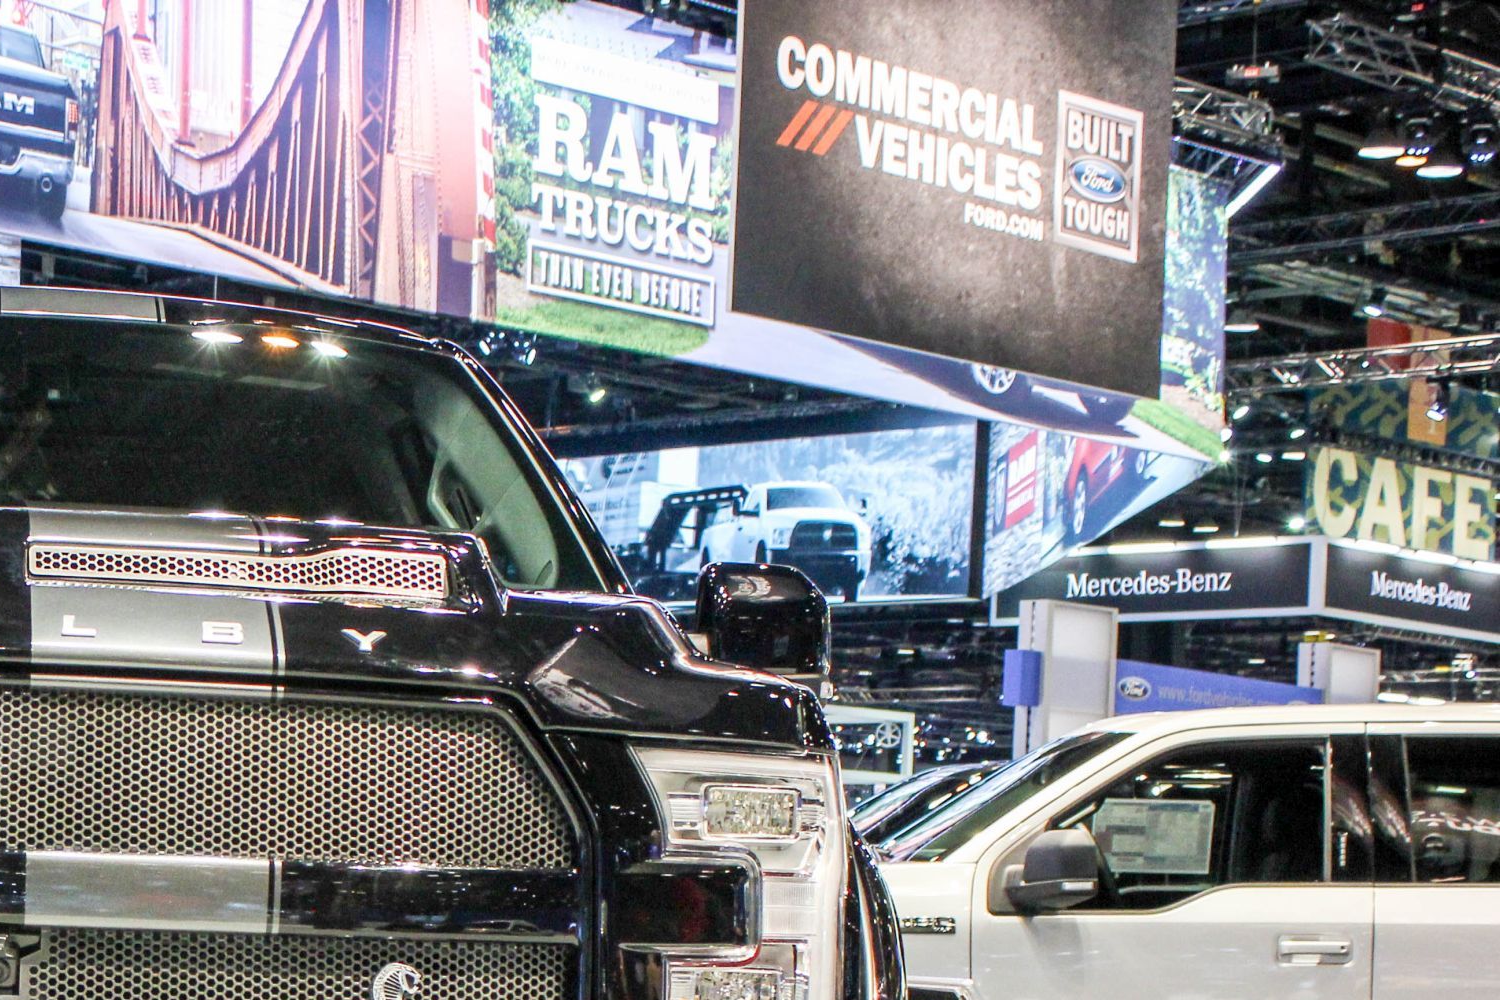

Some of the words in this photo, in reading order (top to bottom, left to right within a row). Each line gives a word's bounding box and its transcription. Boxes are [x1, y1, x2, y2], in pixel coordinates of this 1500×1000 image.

[776, 35, 1043, 156] COMMERCIAL
[532, 93, 716, 210] RAM
[855, 114, 1042, 210] VEHICLES
[1067, 109, 1134, 162] BUILT
[531, 182, 713, 264] TRUCKS
[964, 202, 1043, 241] FORD.COM
[1064, 196, 1130, 241] TOUGH
[539, 251, 585, 291] THAN
[591, 261, 633, 300] EVER
[640, 272, 702, 316] BEFORE
[1314, 447, 1492, 561] CAFE
[1066, 568, 1232, 599] Mercedes-Benz
[1370, 570, 1471, 611] Mercedes-Benz
